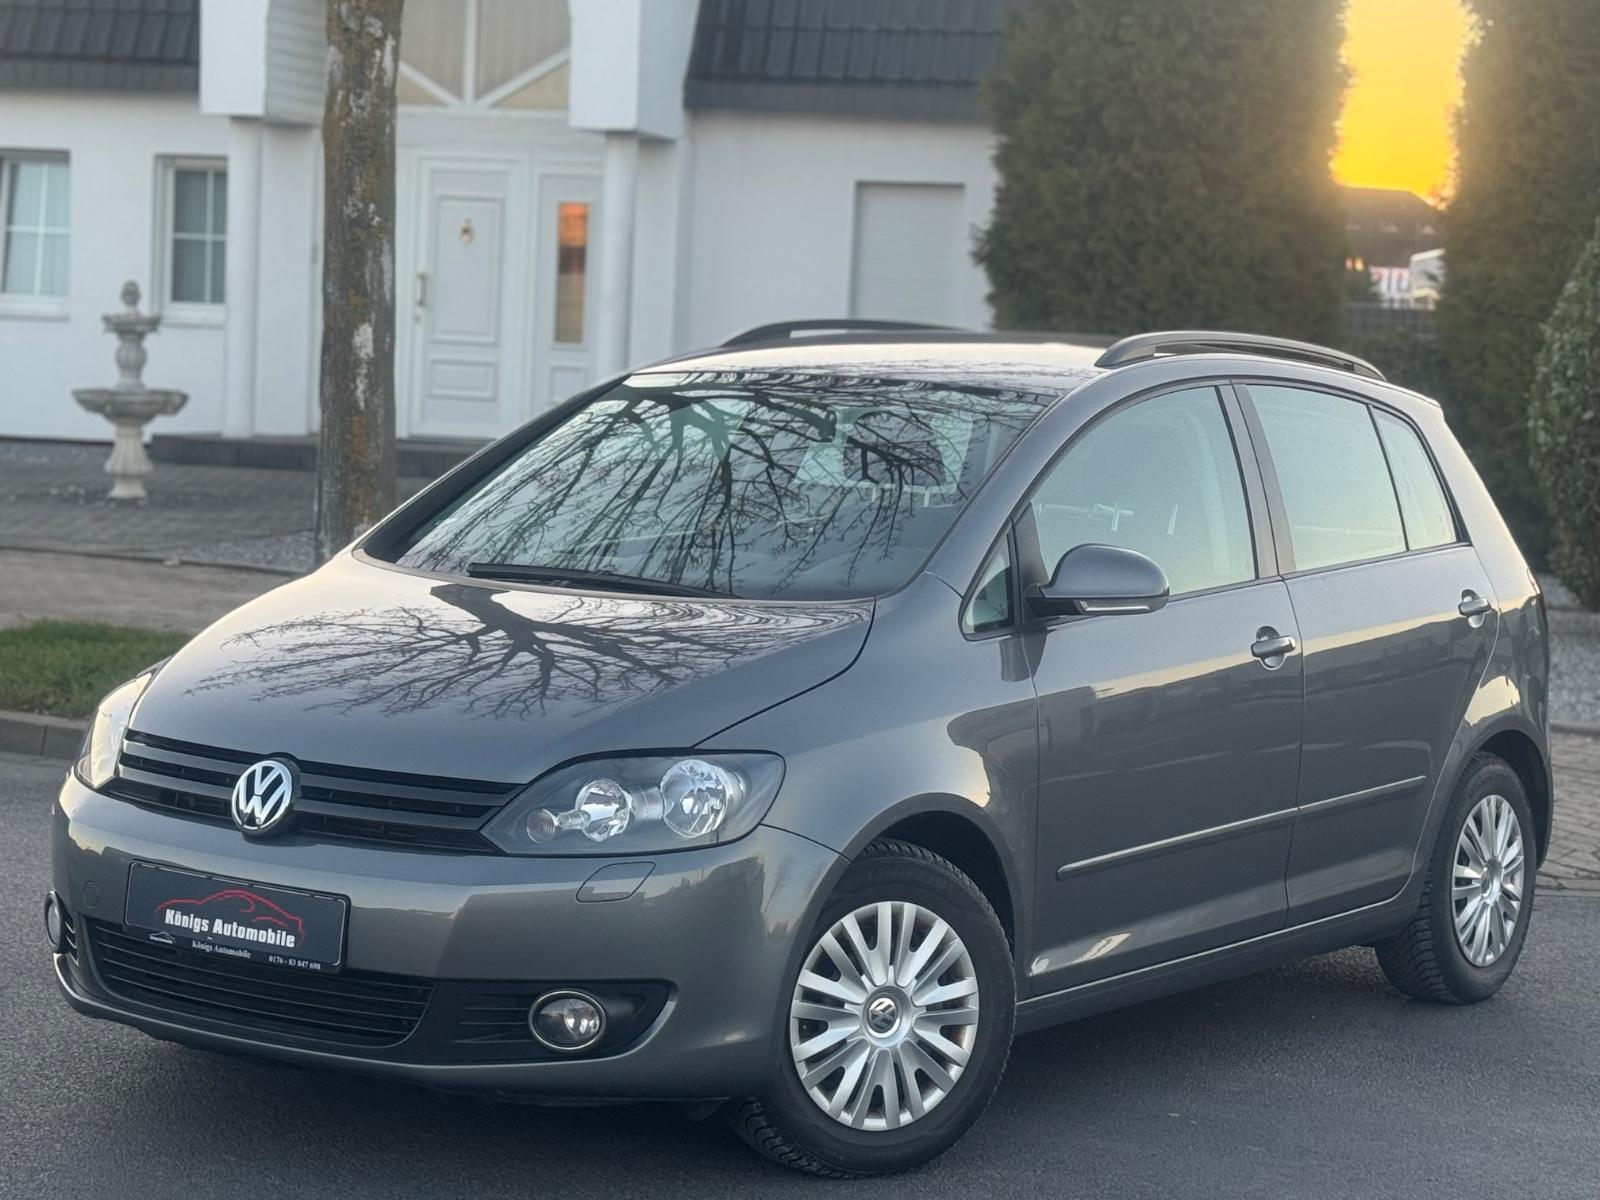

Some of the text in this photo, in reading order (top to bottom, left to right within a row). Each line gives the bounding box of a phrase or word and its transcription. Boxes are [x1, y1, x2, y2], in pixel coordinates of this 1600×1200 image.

[165, 908, 296, 948] Königs Automobile
[213, 945, 252, 959] Automobile
